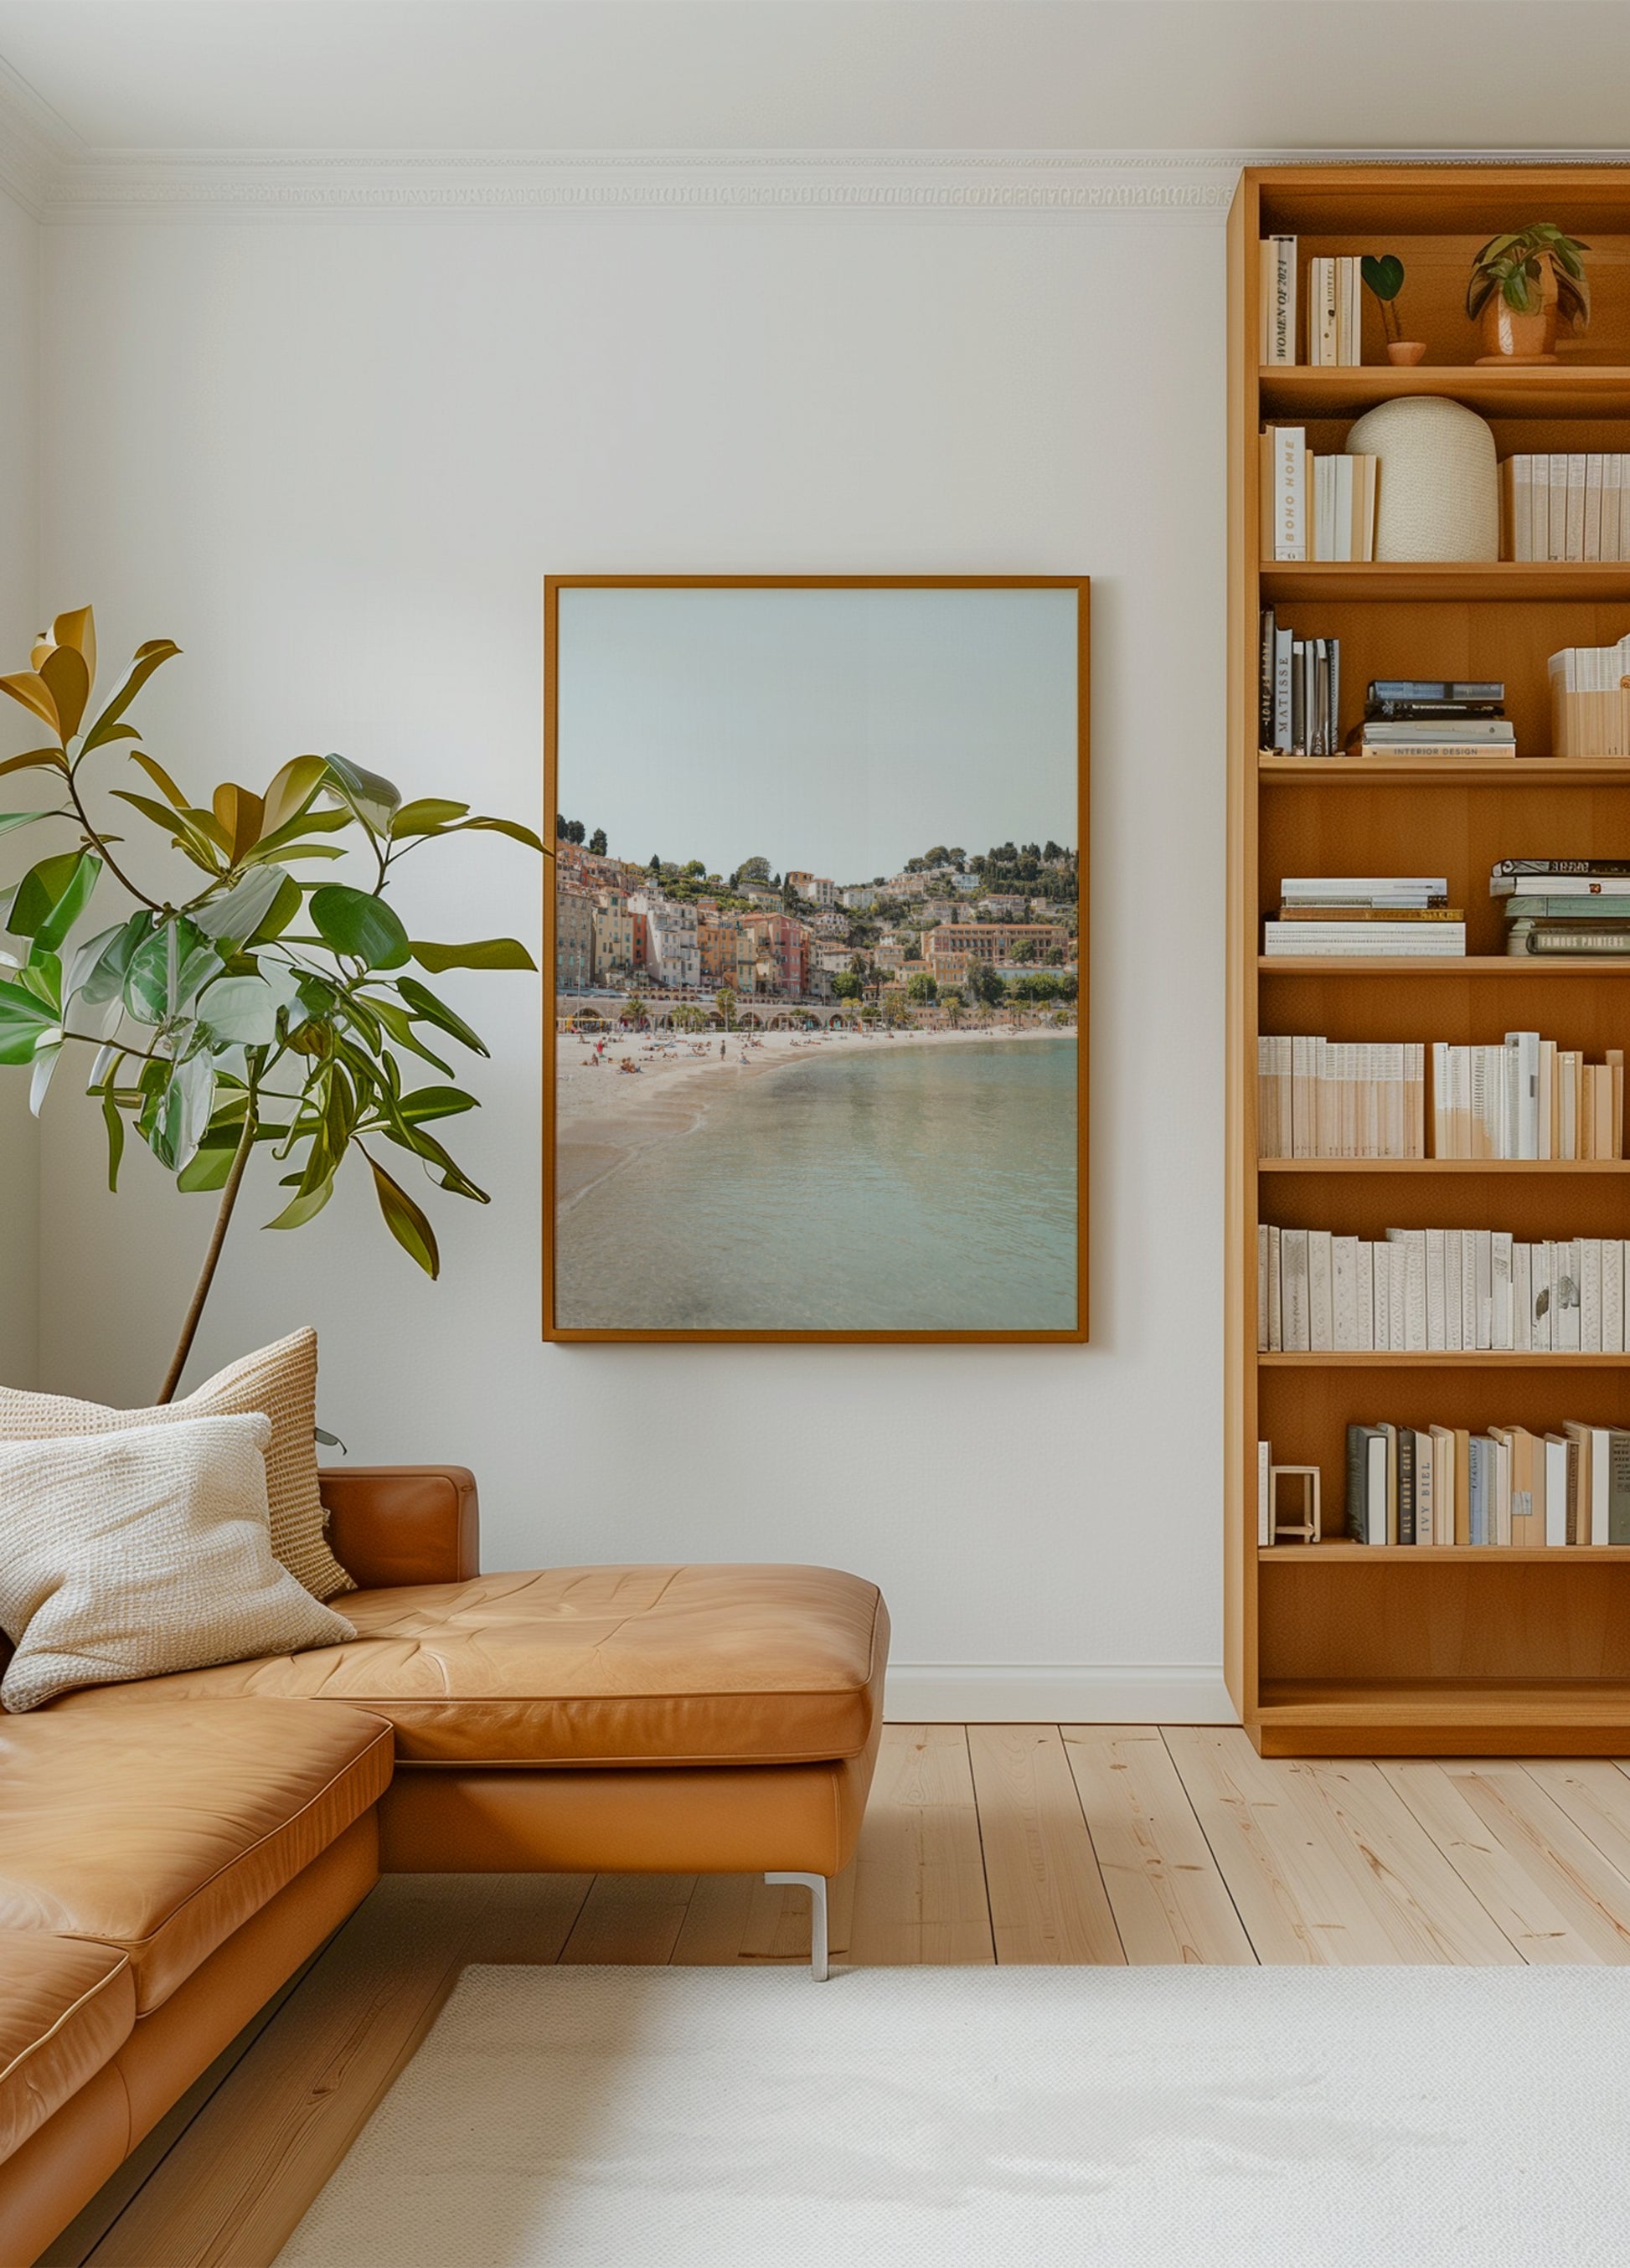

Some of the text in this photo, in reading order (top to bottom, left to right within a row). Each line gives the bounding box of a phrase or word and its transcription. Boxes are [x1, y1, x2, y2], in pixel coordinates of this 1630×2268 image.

[1277, 260, 1287, 358] WOMEN OF 2024
[1285, 441, 1294, 542] BOHO HOME
[1279, 657, 1288, 732] MATISSE
[1541, 937, 1624, 946] FAMOUS PAINTERS
[1421, 1462, 1431, 1532] IVY BIEL
